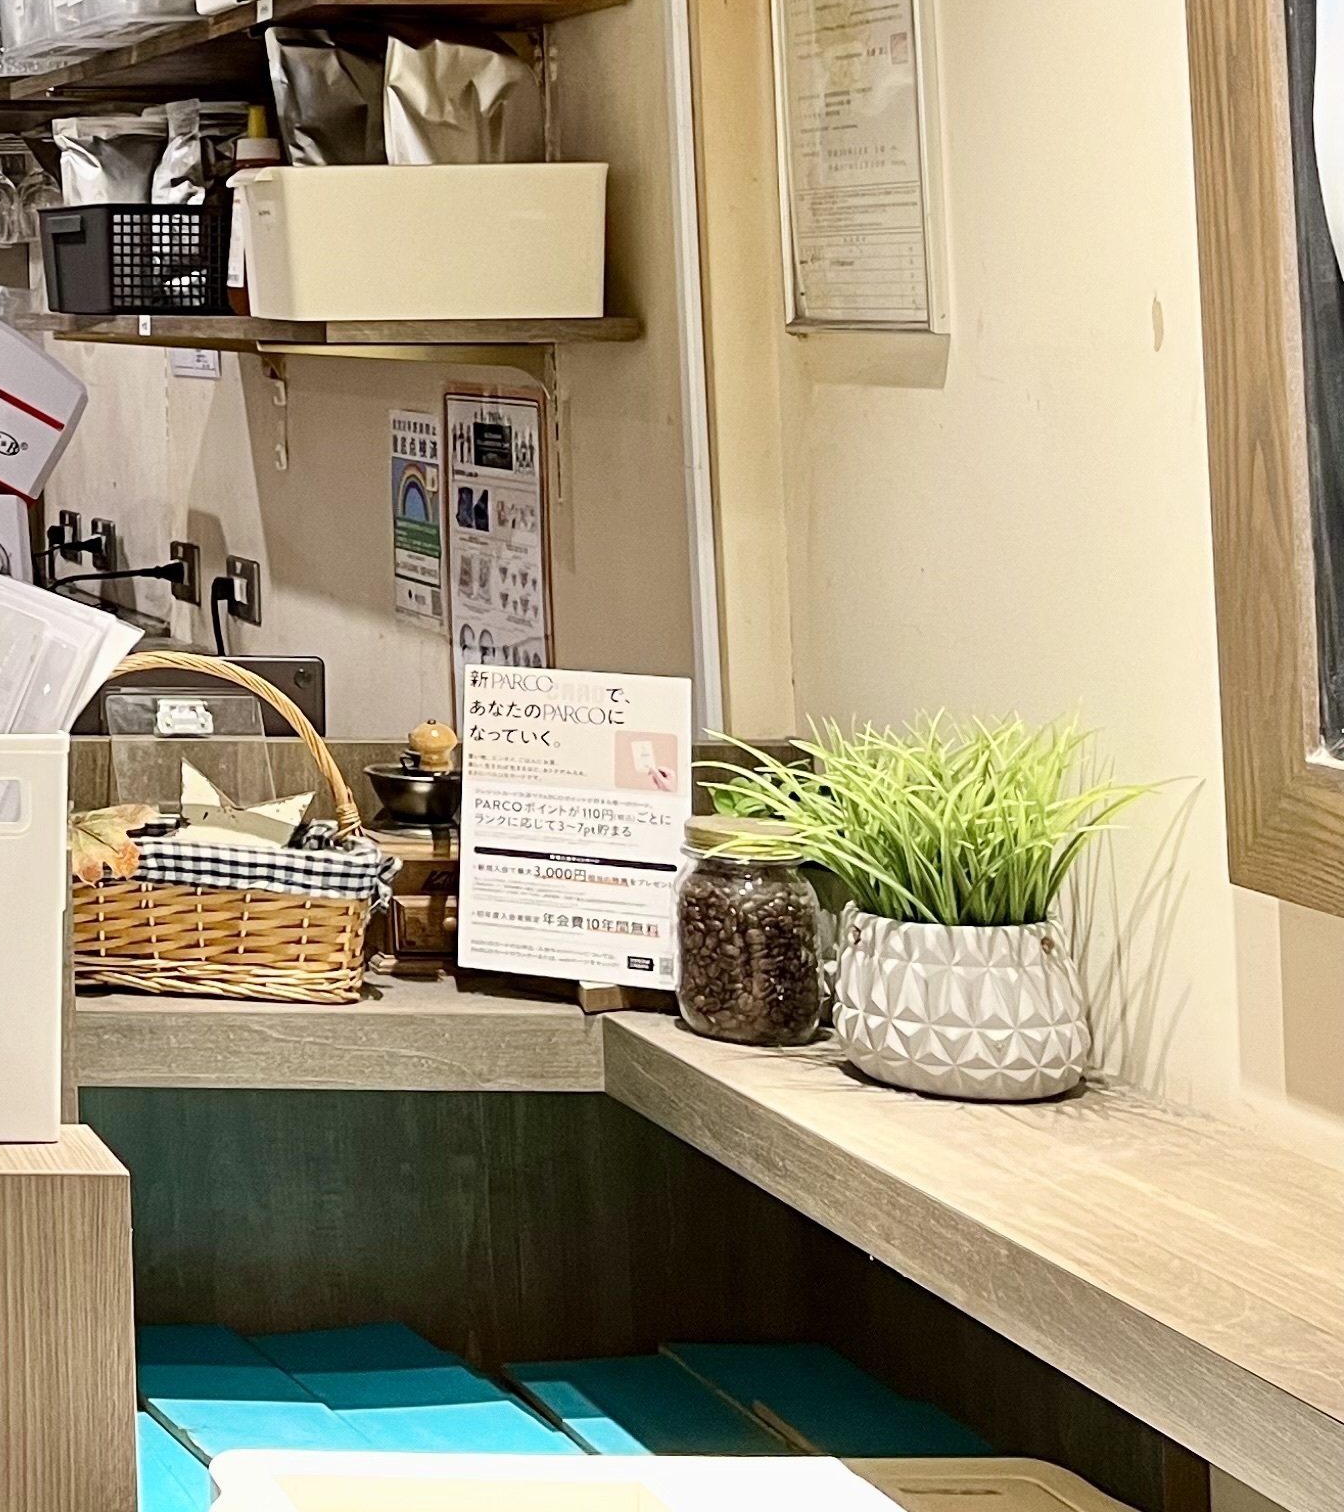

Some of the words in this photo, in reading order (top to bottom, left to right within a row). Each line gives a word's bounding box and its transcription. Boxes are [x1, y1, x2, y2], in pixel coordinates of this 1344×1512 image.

[469, 699, 626, 726] あなたのPARCOに
[469, 724, 562, 749] なっていく。
